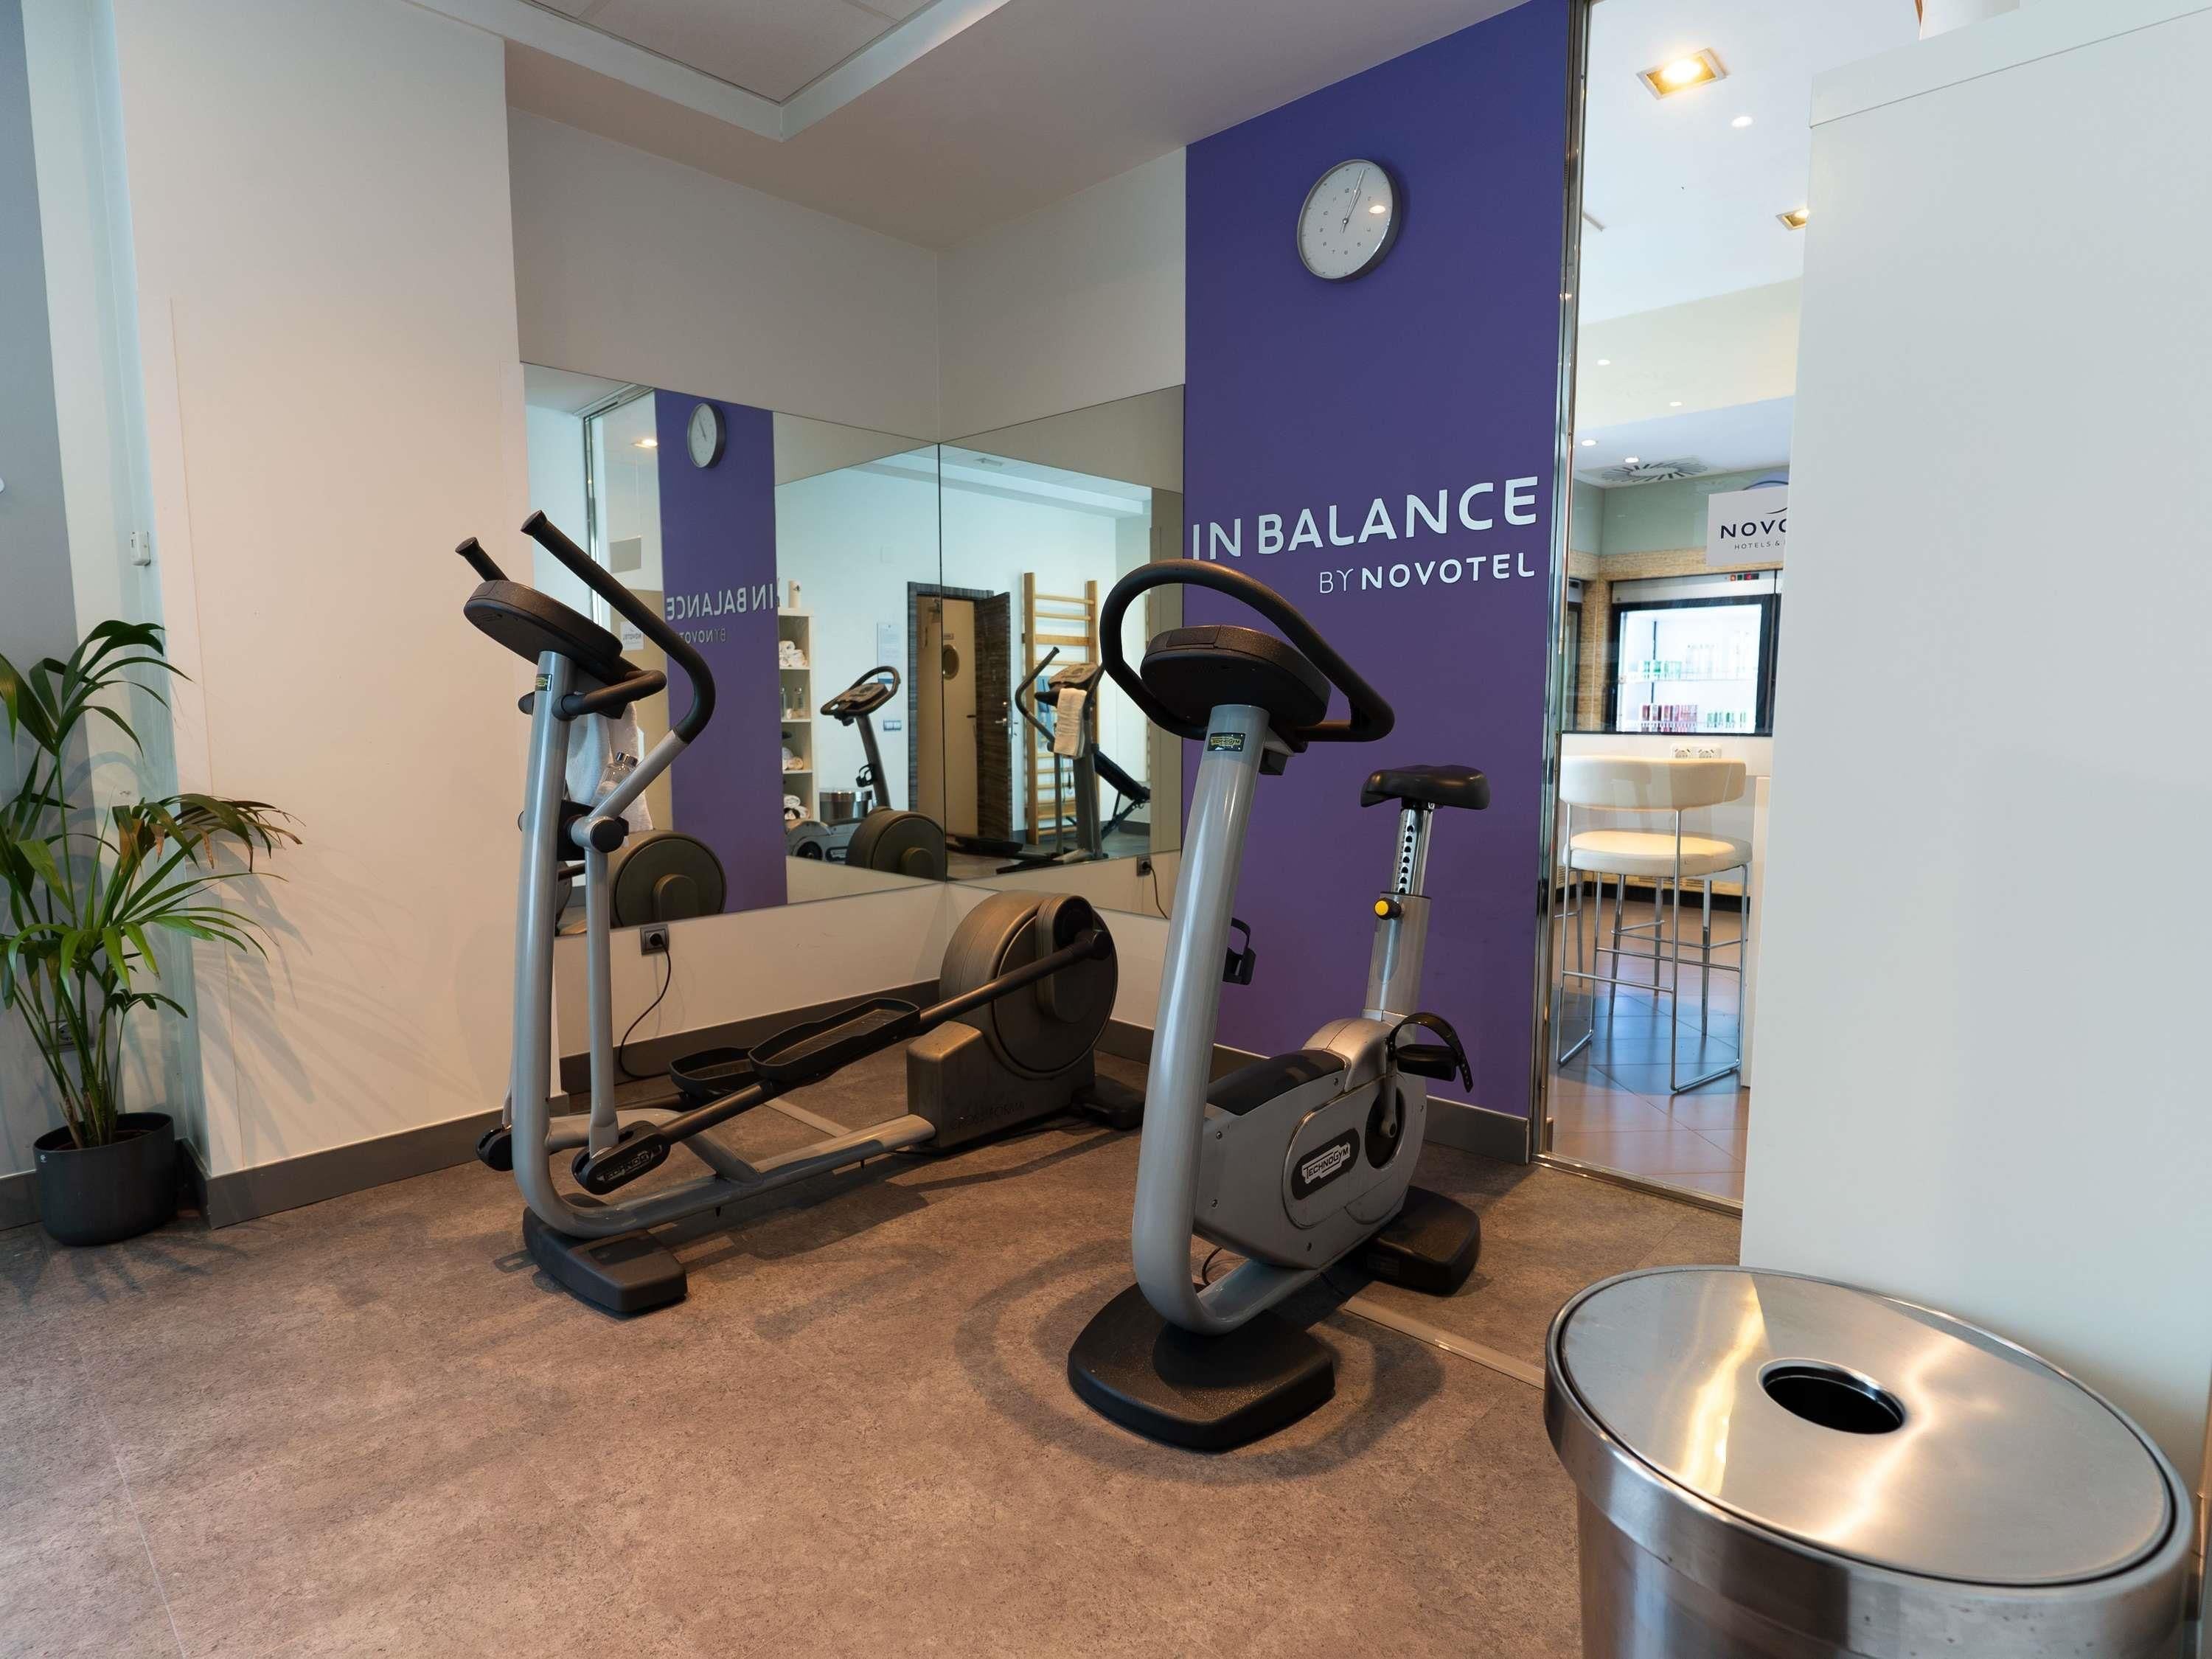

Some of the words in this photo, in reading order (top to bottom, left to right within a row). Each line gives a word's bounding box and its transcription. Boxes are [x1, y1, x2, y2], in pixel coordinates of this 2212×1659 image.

[1192, 518, 1242, 561] IN
[1257, 476, 1539, 555] BALANCE
[1734, 541, 1771, 550] HOTELS
[1319, 568, 1354, 594] BY
[1361, 552, 1536, 590] NOVOTEL
